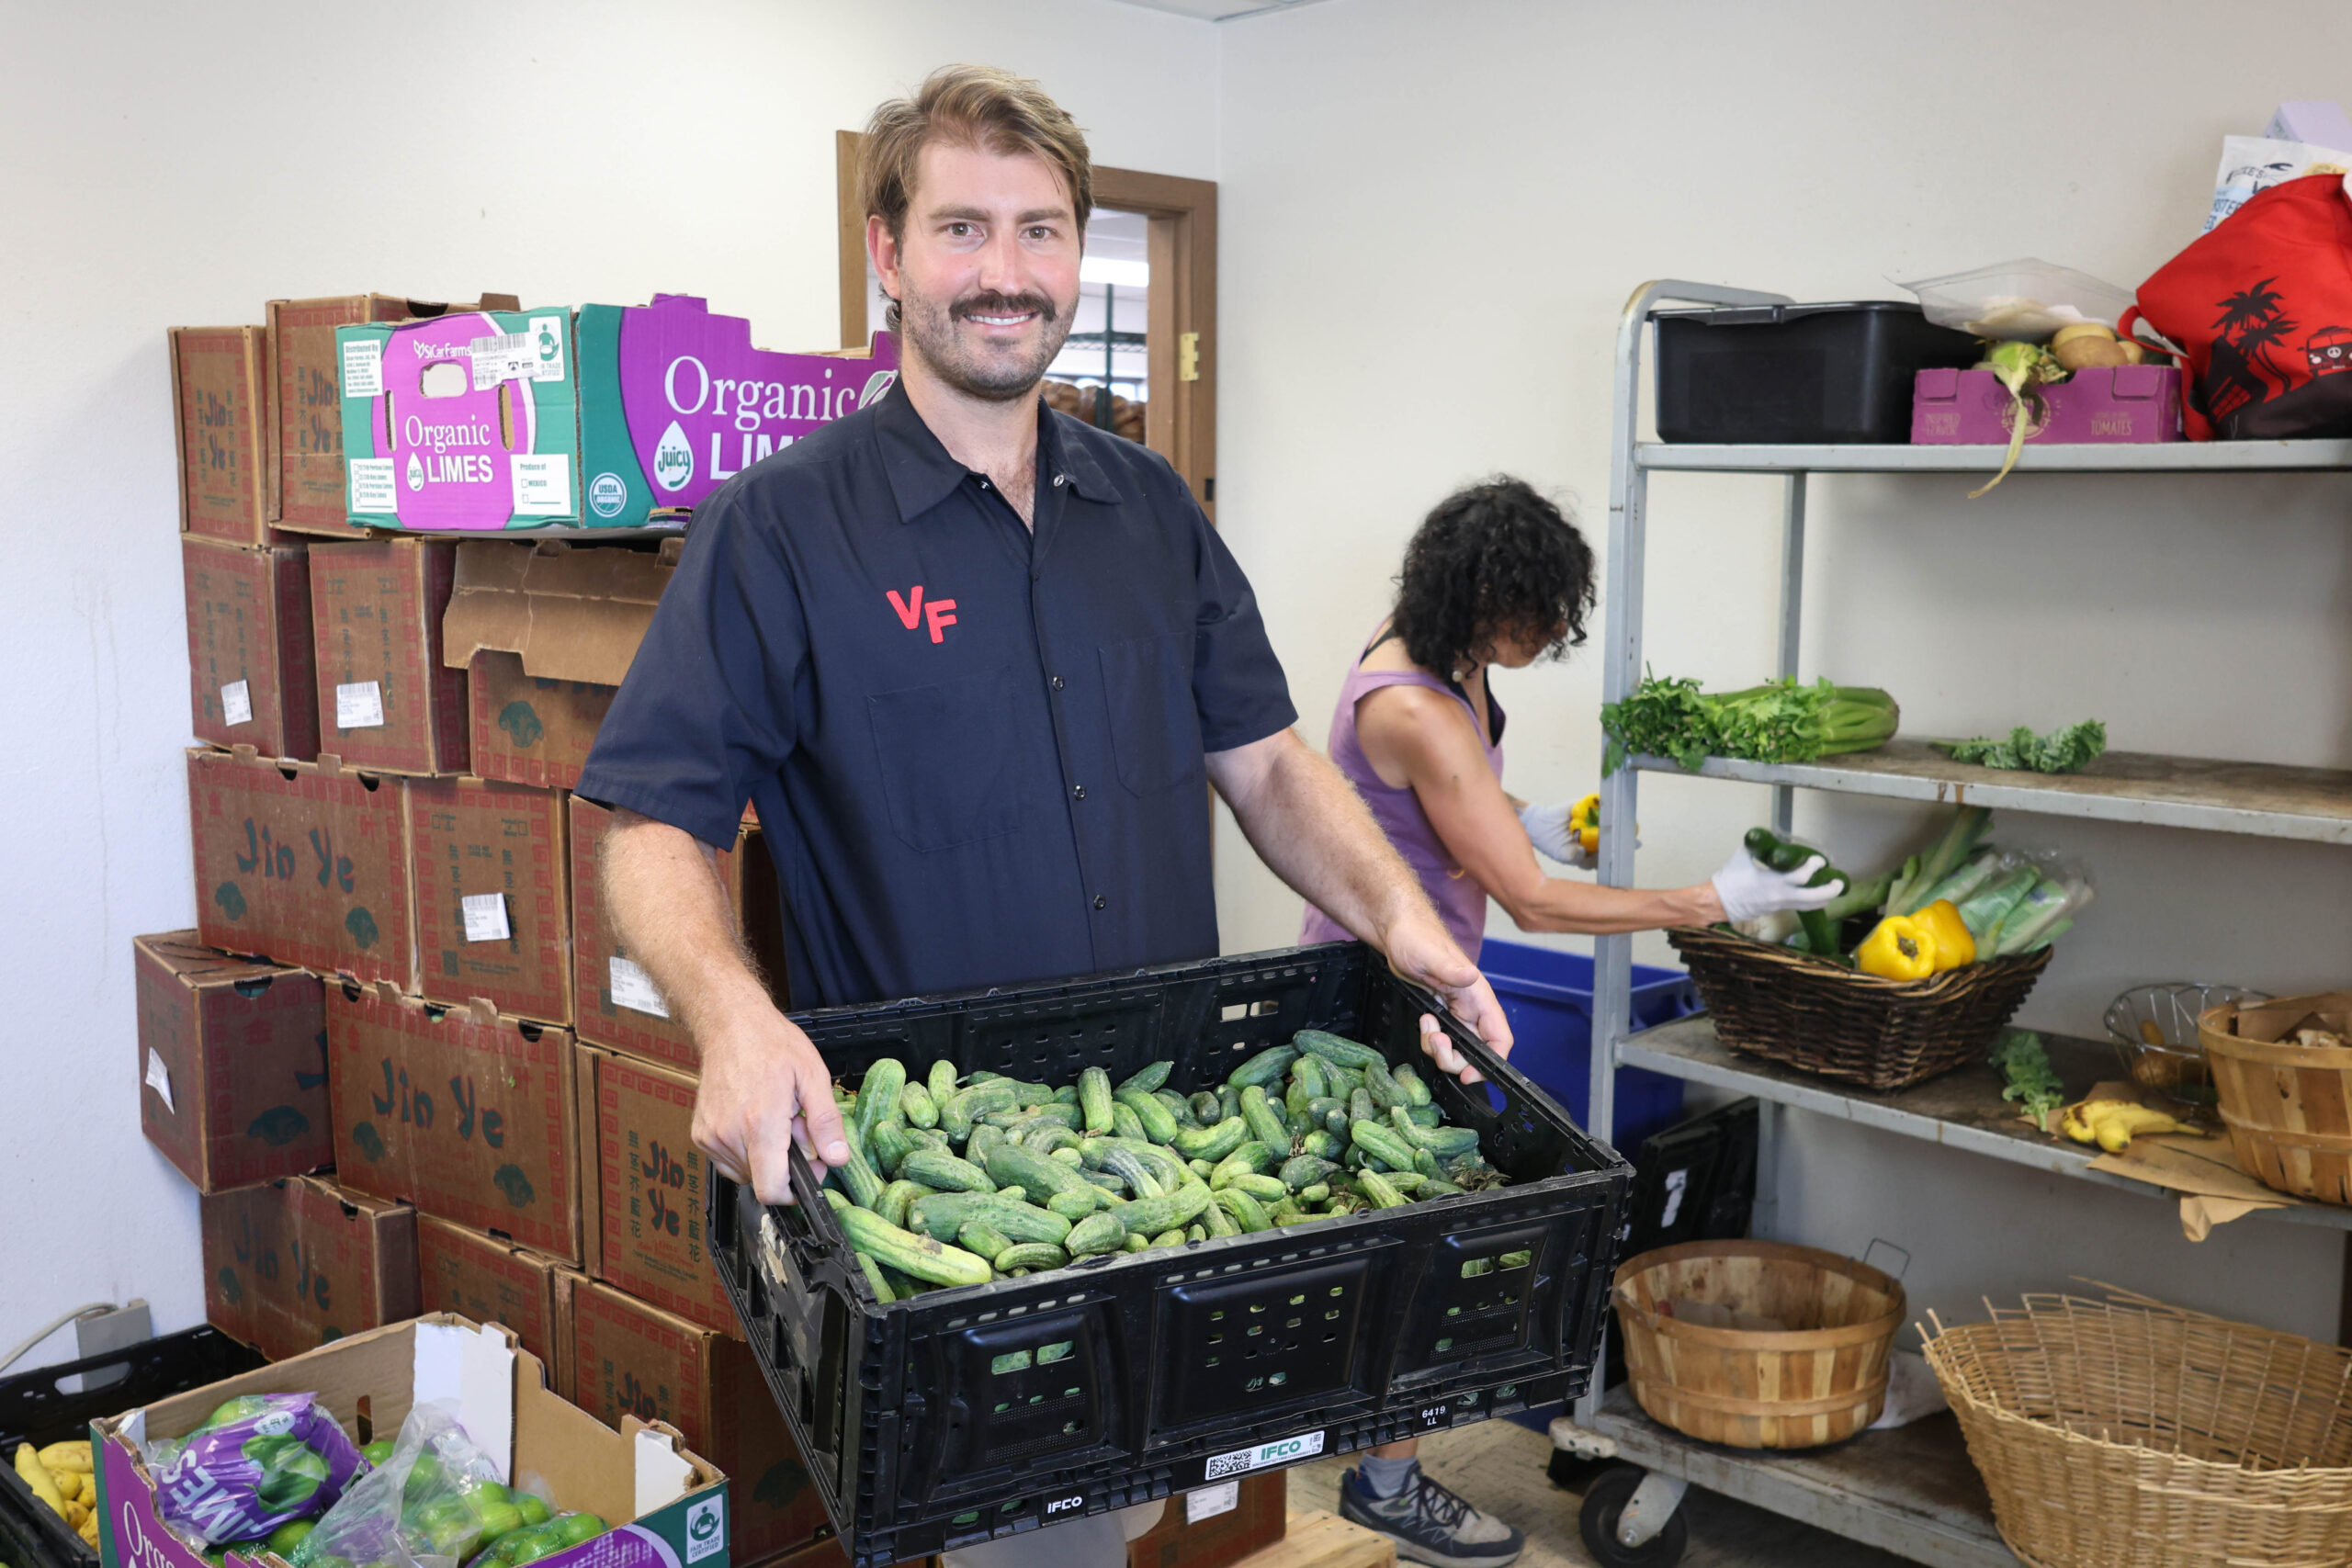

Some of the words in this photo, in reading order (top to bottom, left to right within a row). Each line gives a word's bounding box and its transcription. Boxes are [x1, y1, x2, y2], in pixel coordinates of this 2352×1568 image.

[664, 355, 856, 431] Organic
[405, 414, 492, 454] Organic
[426, 455, 493, 482] LIMES
[658, 446, 690, 475] juicy
[598, 484, 617, 493] USDA
[886, 585, 957, 644] VF
[235, 816, 296, 881] Jin
[308, 827, 356, 894] Ye
[371, 1057, 434, 1130] Jin
[449, 1074, 504, 1149] Ye
[642, 1141, 685, 1190] Jin
[647, 1188, 681, 1236] Ye
[234, 1212, 278, 1280] Jin
[290, 1240, 330, 1311] Ye
[616, 1371, 656, 1419] Jin
[1421, 1405, 1446, 1418] 6419
[1427, 1417, 1437, 1427] LL
[1261, 1439, 1302, 1461] IFCO
[1047, 1495, 1083, 1515] IFCO
[689, 1543, 703, 1554] FAIR
[704, 1535, 720, 1548] TRADE
[691, 1542, 720, 1559] CERTIFIED
